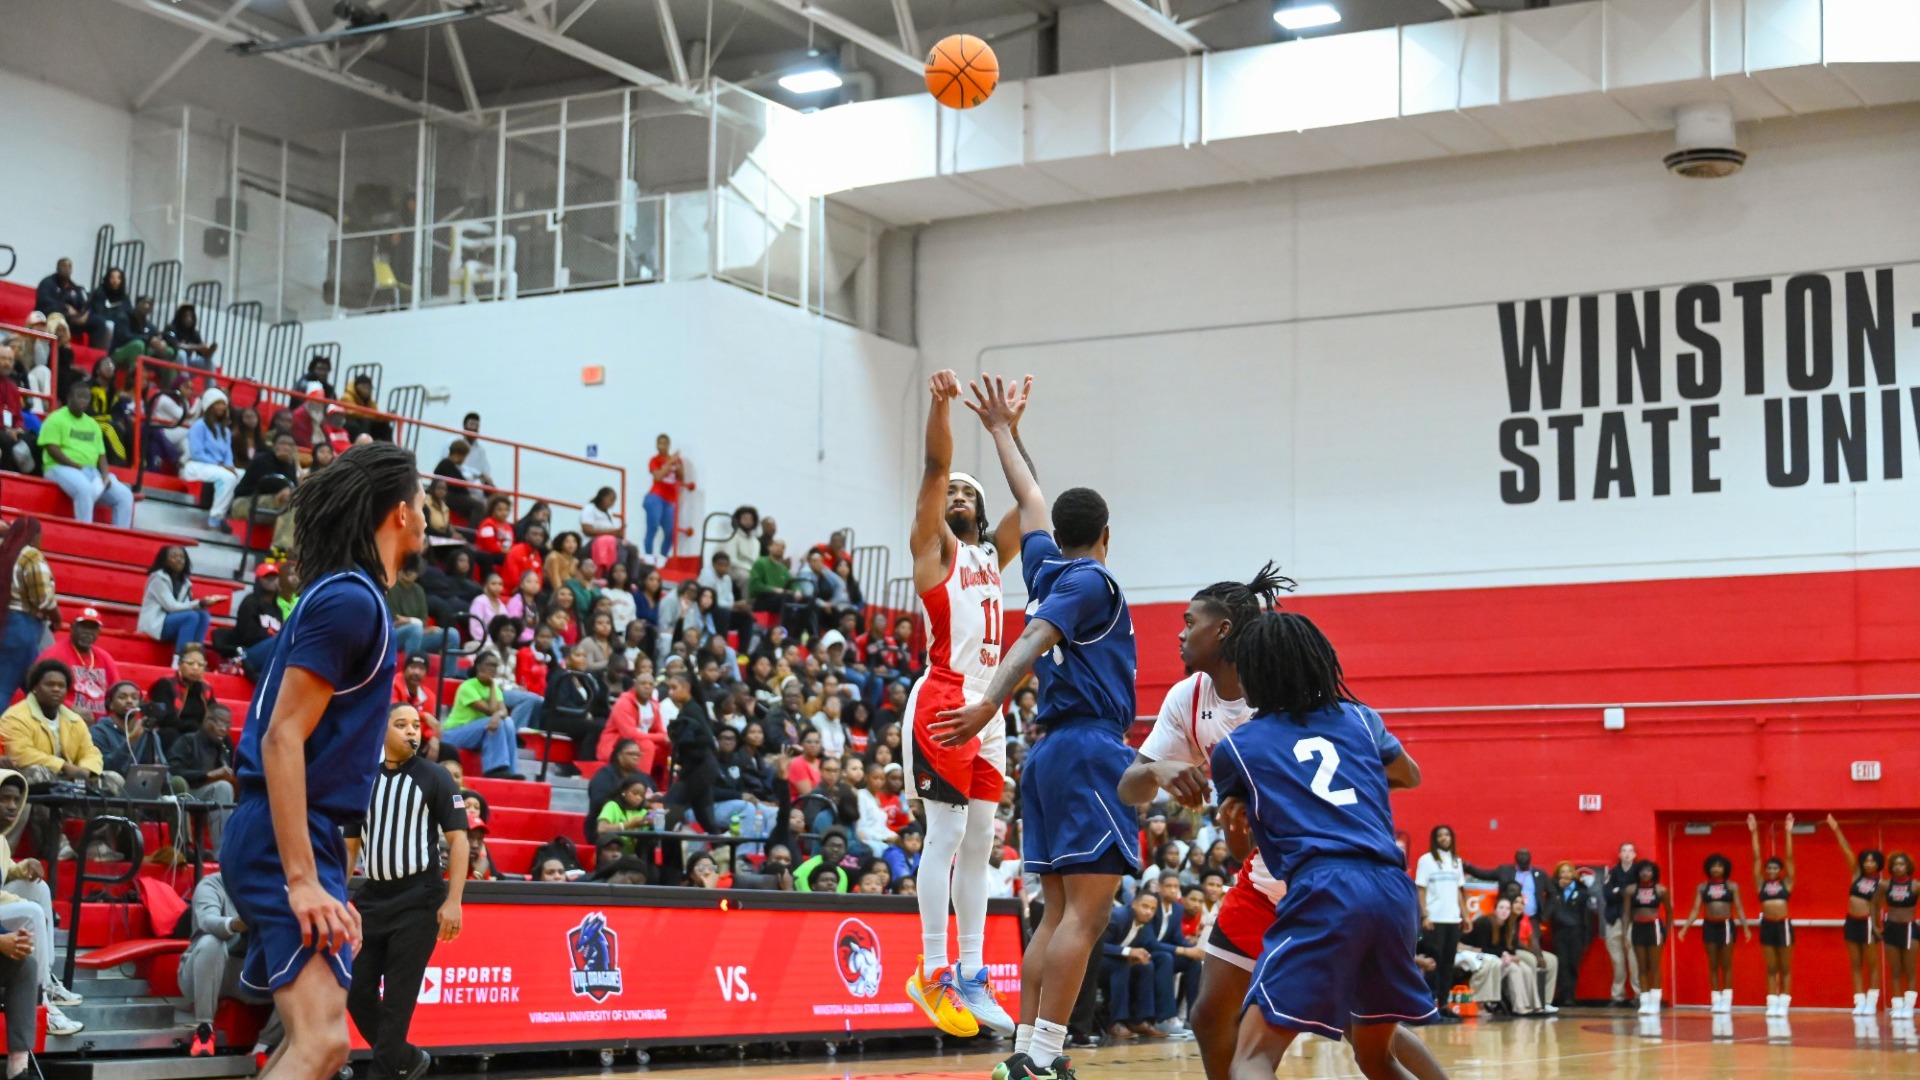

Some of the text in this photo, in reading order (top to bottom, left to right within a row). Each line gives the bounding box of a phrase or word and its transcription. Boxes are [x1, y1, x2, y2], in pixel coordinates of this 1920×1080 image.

[1499, 387, 1920, 505] STATE UNI
[981, 598, 1000, 646] 11
[1293, 735, 1359, 807] 2
[445, 966, 512, 983] SPORTS
[714, 965, 758, 1002] VS.
[443, 986, 520, 1004] NETWORK
[529, 1008, 668, 1024] VIRGINIA UNIVERSITY OF LYNCHBURG
